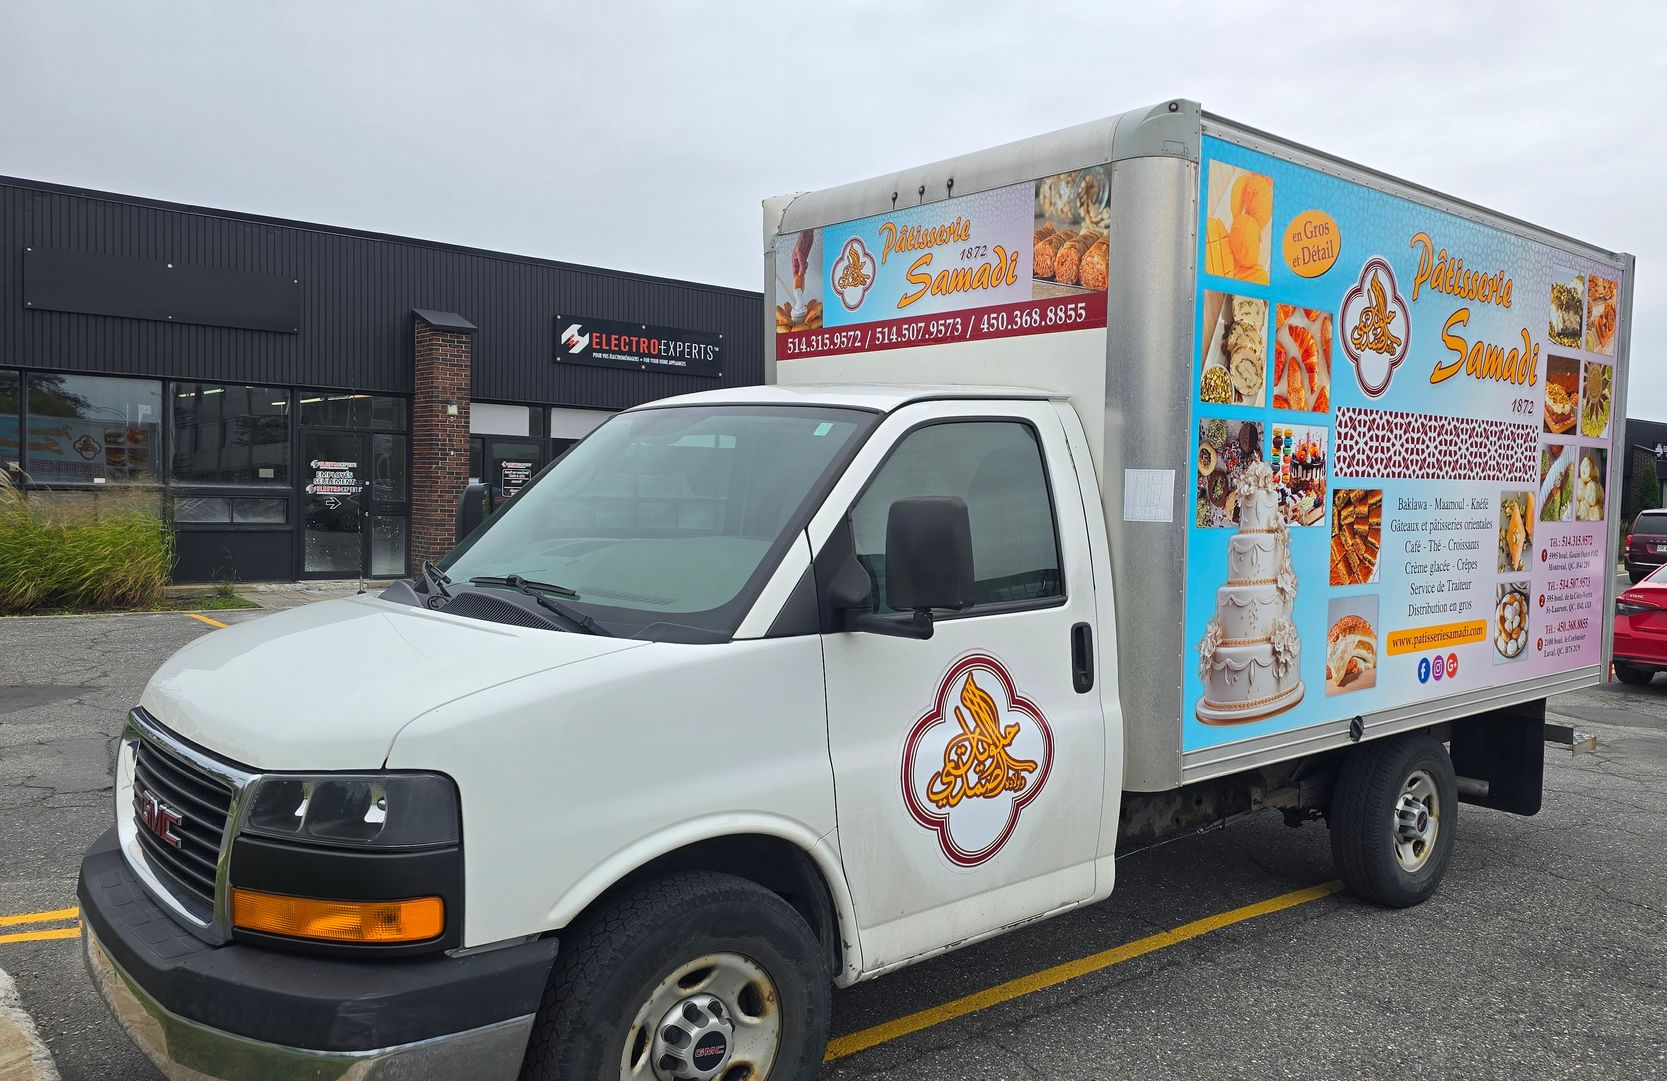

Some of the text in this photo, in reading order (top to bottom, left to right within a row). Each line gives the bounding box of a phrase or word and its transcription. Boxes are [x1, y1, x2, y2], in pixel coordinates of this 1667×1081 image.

[878, 216, 971, 264] Pâtisserie
[1292, 220, 1330, 243] en Gros
[959, 245, 988, 262] 1872
[1292, 240, 1335, 267] et Détail
[897, 245, 1019, 310] Samadi
[1410, 231, 1513, 309] Pâtisserie
[787, 302, 1087, 354] 514.315.9572 / 514.507.9573 / 450.368.8855
[1429, 307, 1540, 387] Samadi
[1511, 398, 1534, 415] 1872
[1398, 497, 1428, 511] Baklawa
[1435, 497, 1464, 510] Maamoul
[1390, 518, 1493, 534] Gâteaux et pâtisseries orientales
[1404, 539, 1421, 553] Café
[1429, 539, 1441, 552] Thé
[1448, 538, 1479, 552] Croissants
[1404, 561, 1428, 575] Crème
[1429, 560, 1450, 576] glacée
[1456, 558, 1478, 573] Crêpes
[1410, 579, 1472, 595] Service de Traiteur
[1408, 600, 1472, 617] Distribution en gros
[1392, 625, 1483, 648] www.patisseriesamadi.com
[694, 1044, 725, 1057] GMC
